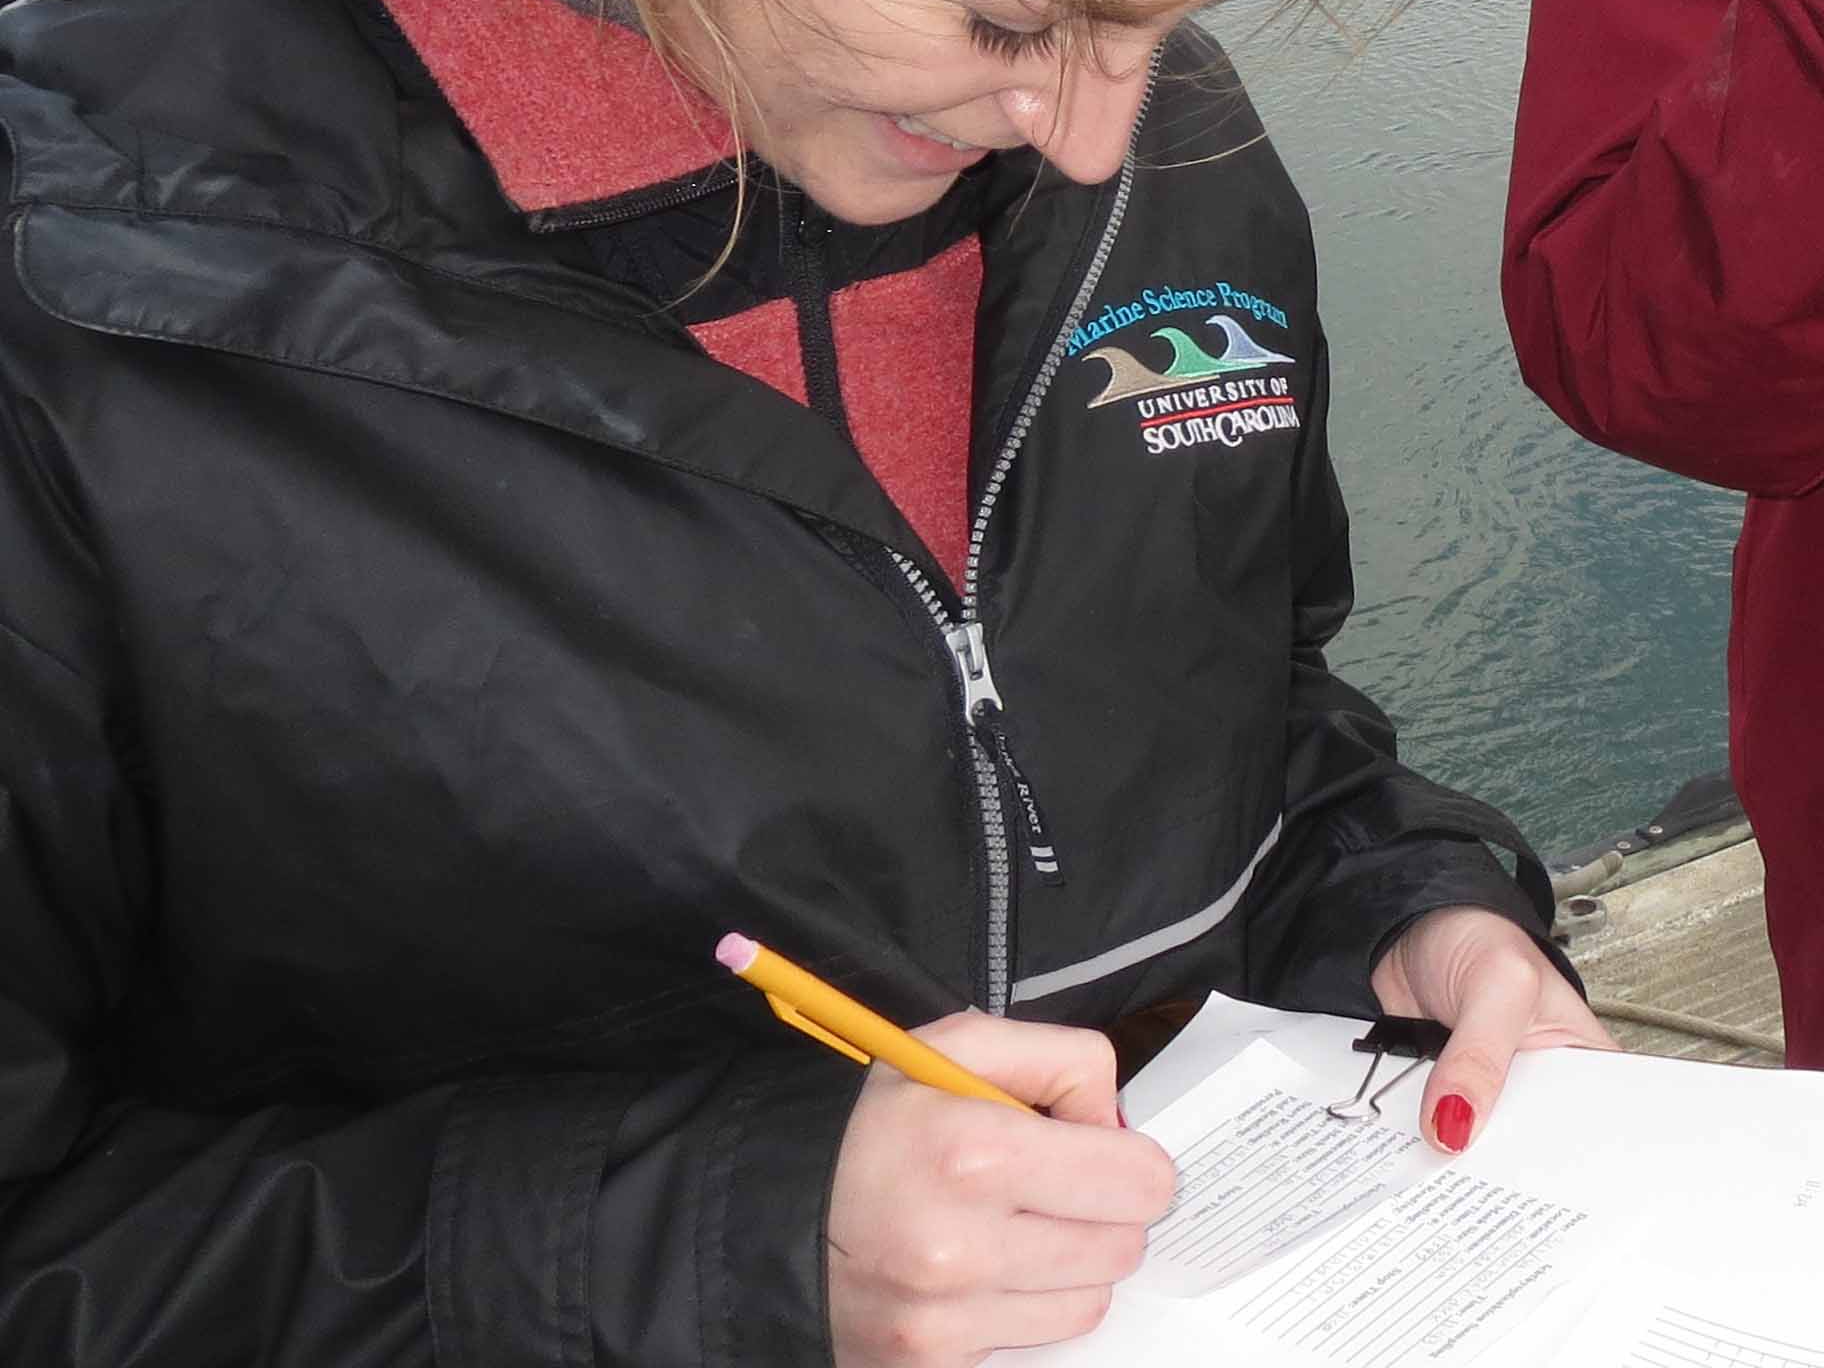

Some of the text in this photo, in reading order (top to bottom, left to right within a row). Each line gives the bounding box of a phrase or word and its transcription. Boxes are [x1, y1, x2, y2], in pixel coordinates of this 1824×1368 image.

[1066, 281, 1289, 357] Marine Science Program
[1137, 376, 1290, 419] UNIVERSITY OF
[1016, 783, 1042, 834] River
